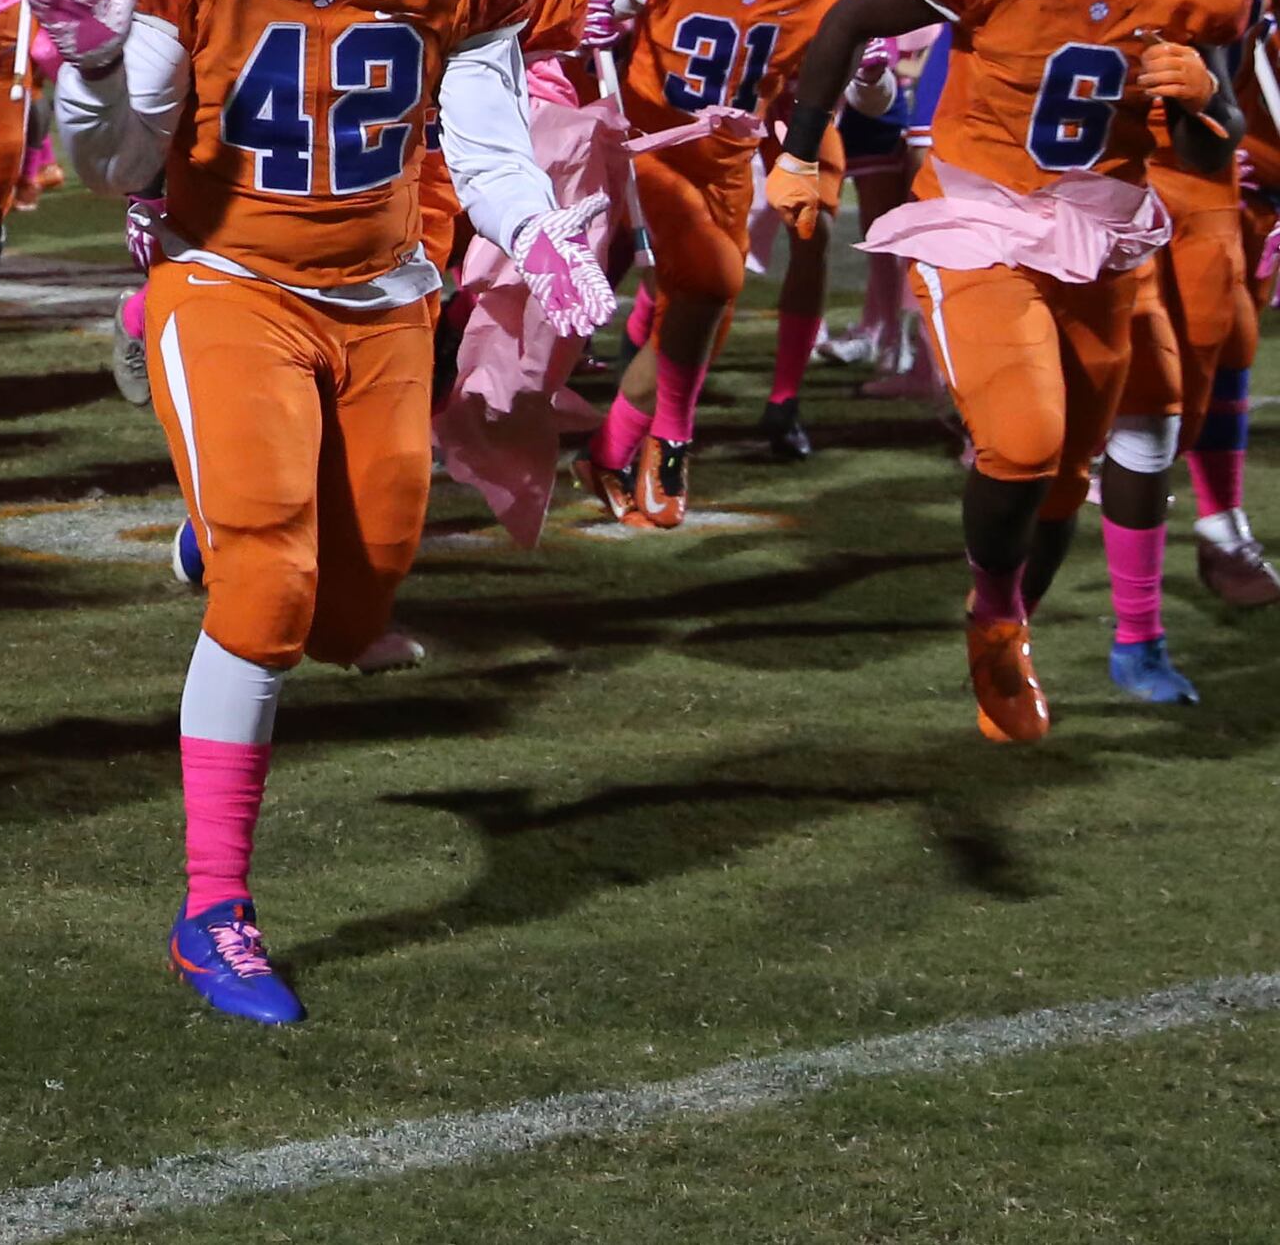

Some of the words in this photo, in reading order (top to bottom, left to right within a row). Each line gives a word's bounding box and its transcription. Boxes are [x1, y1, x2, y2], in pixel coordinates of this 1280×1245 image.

[220, 21, 425, 196] 42
[663, 12, 780, 118] 31
[1025, 42, 1128, 171] 6
